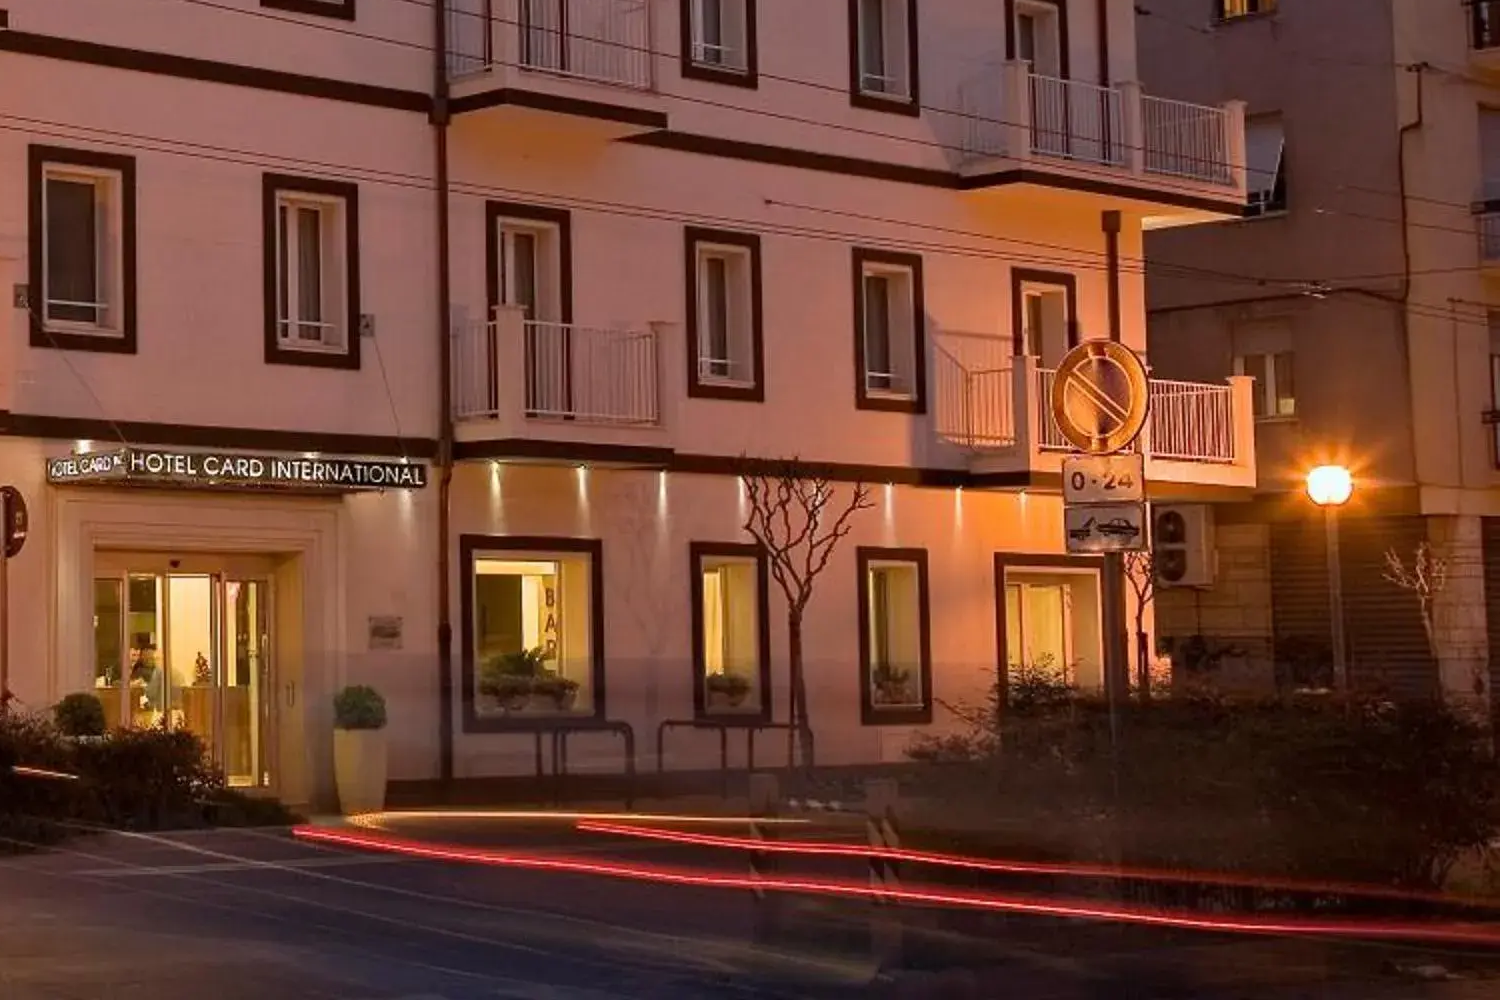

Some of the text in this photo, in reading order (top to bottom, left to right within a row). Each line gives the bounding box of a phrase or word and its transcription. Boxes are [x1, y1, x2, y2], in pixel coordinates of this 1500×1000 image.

[131, 453, 196, 475] HOTEL
[203, 457, 264, 478] CARD
[271, 461, 425, 485] INTERNATIONAL
